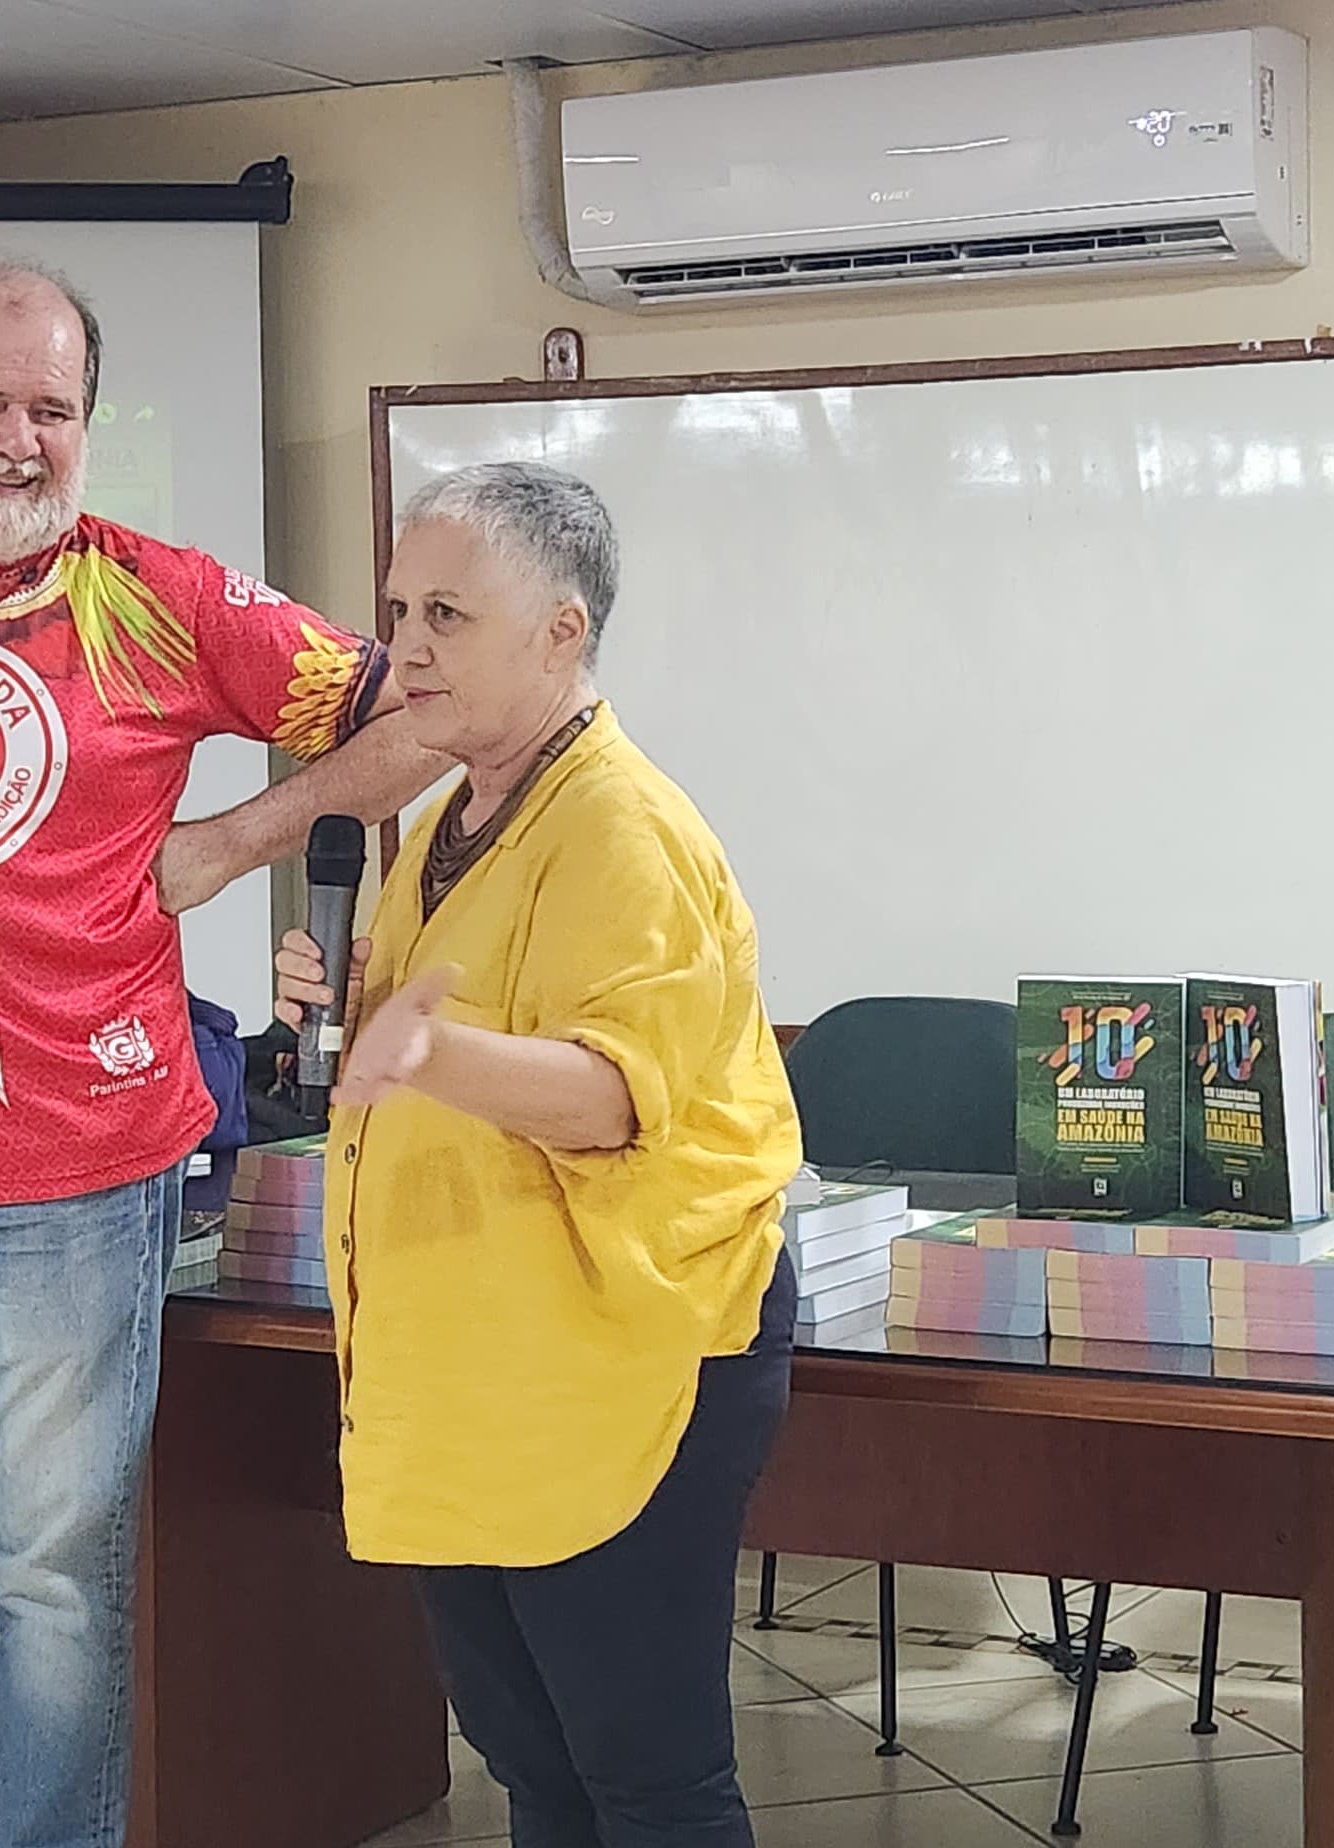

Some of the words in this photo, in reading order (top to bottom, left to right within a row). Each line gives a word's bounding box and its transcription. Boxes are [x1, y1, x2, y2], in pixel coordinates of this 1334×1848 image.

[1060, 1005, 1135, 1081] 10
[1057, 1109, 1076, 1123] EM
[1079, 1108, 1124, 1124] SAÚDE
[1126, 1110, 1145, 1125] NA
[1057, 1122, 1145, 1143] AMAZÔNIA
